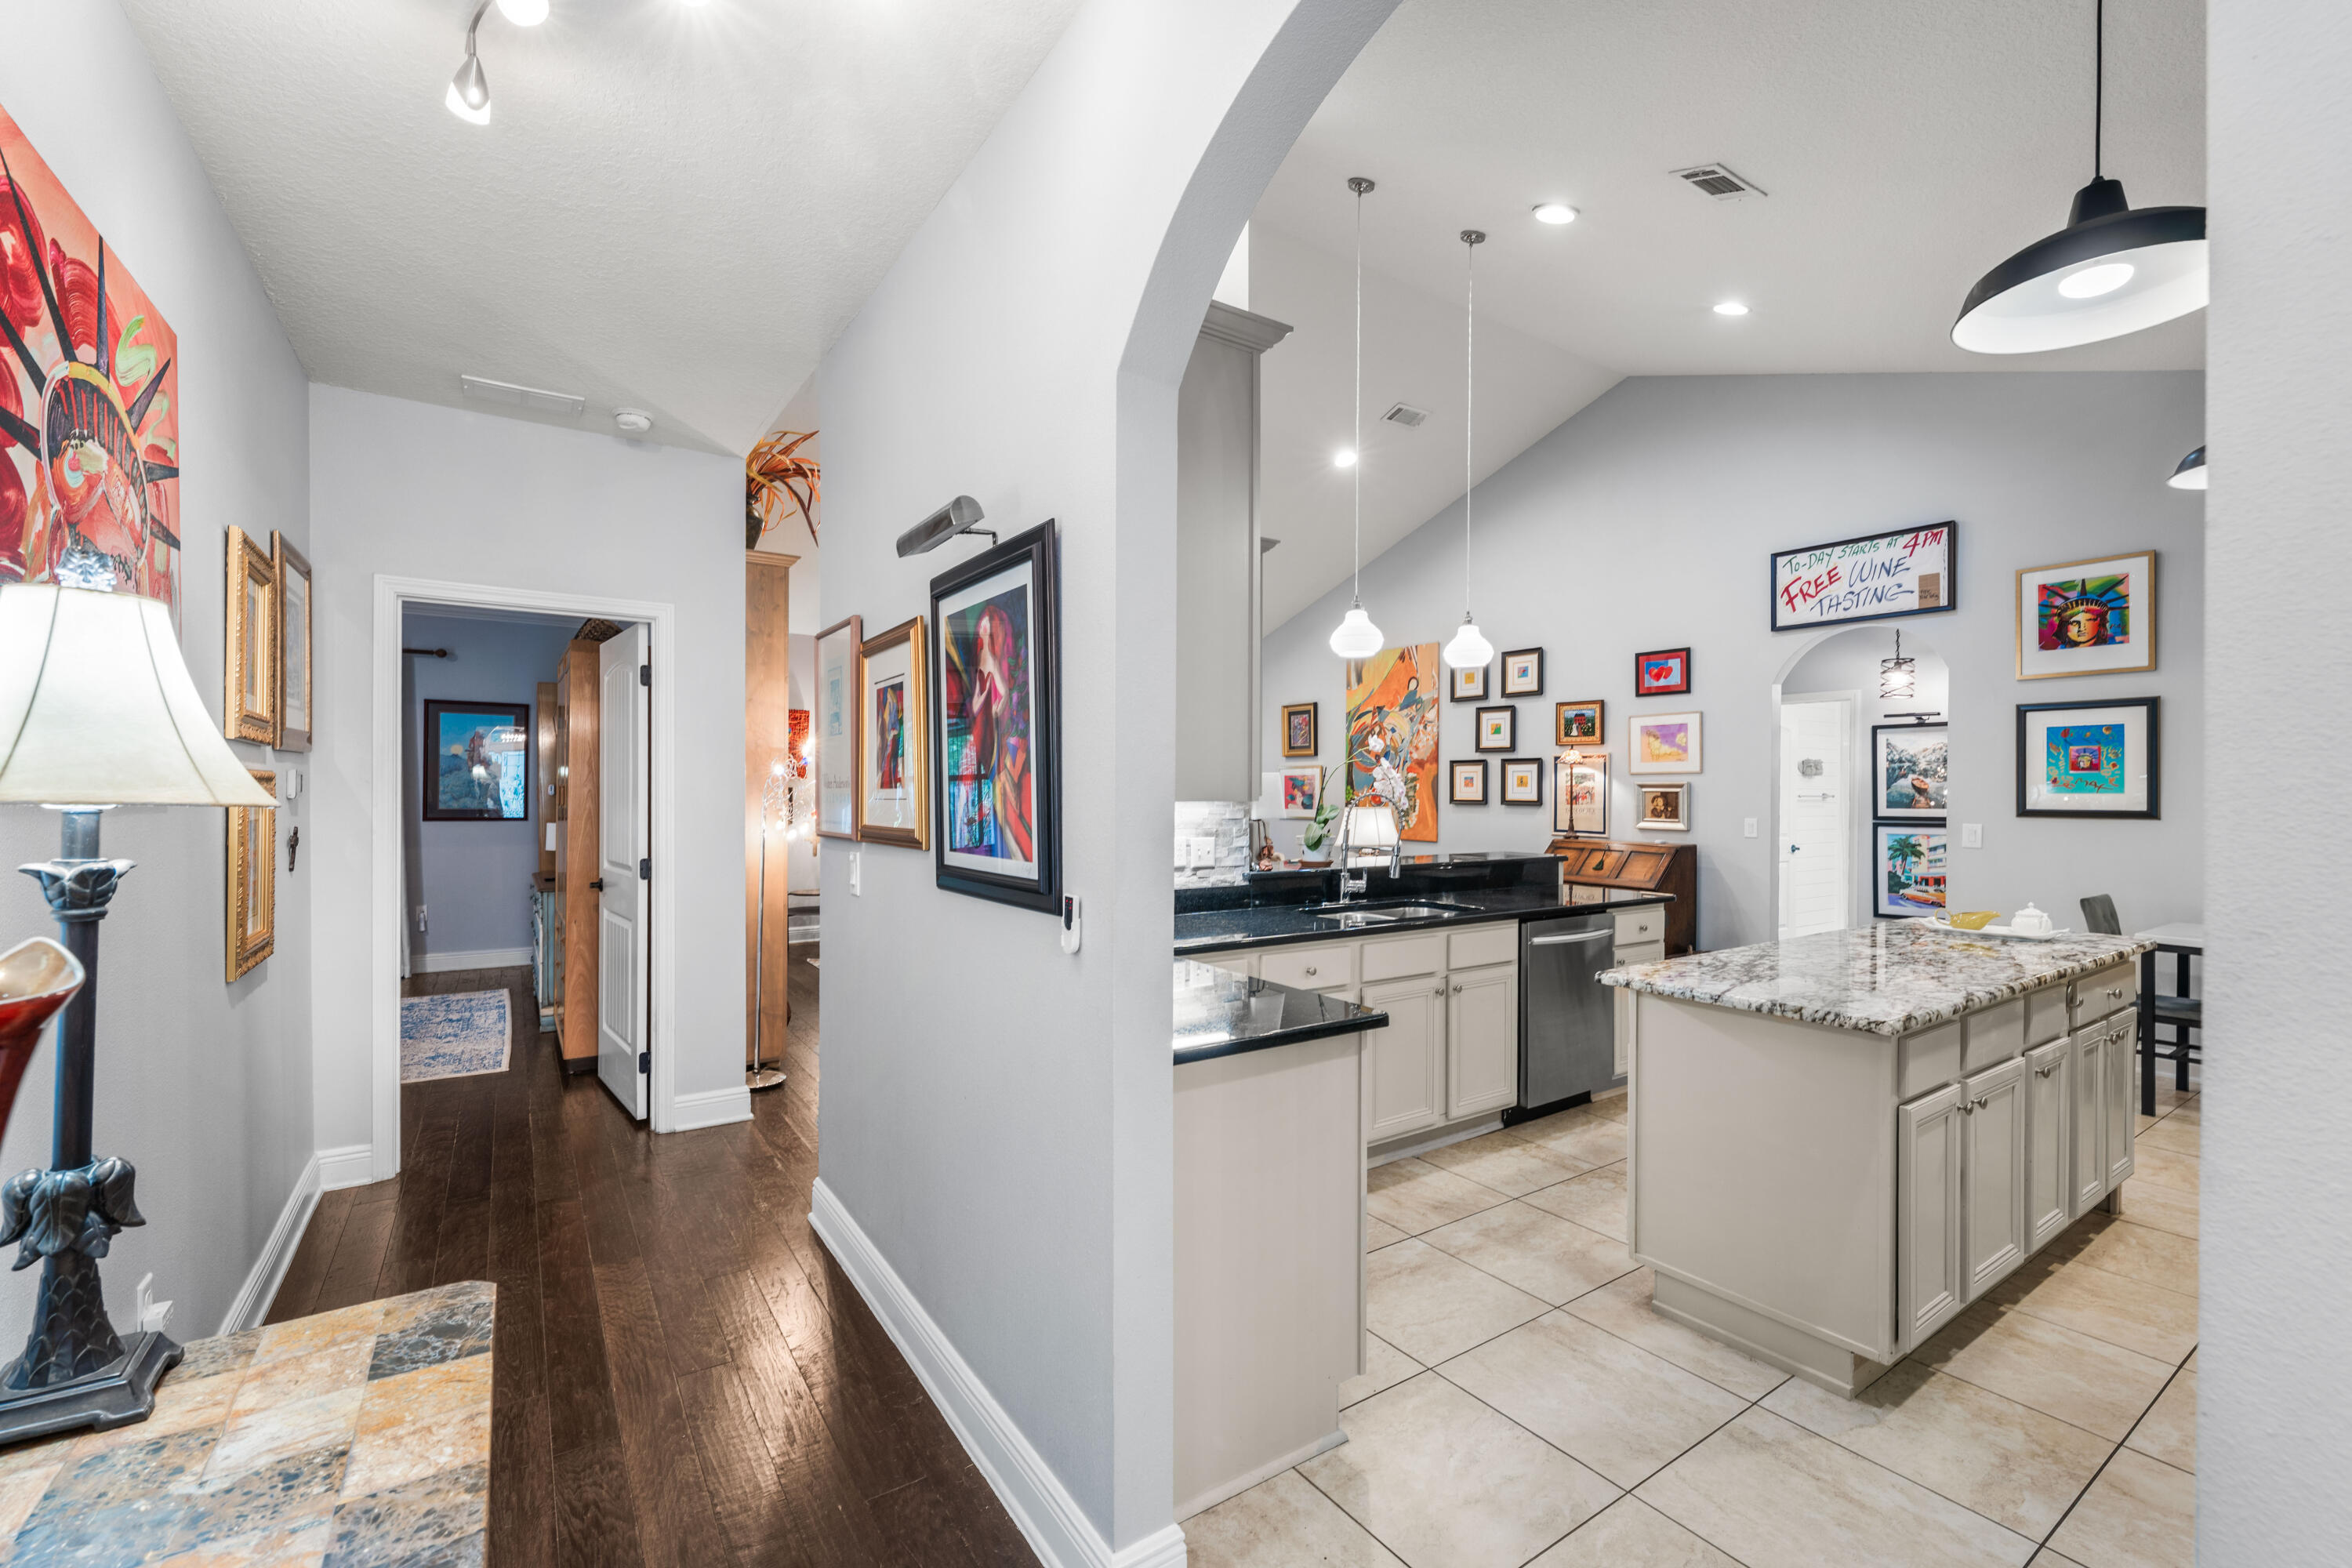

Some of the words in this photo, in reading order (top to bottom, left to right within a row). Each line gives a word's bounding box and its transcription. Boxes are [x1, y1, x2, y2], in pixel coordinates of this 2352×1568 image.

[1838, 539, 1880, 559] STARTS
[1886, 535, 1904, 549] AT
[1780, 565, 1842, 613] FREE
[1849, 556, 1911, 588] WINE
[1809, 583, 1915, 616] TASTING
